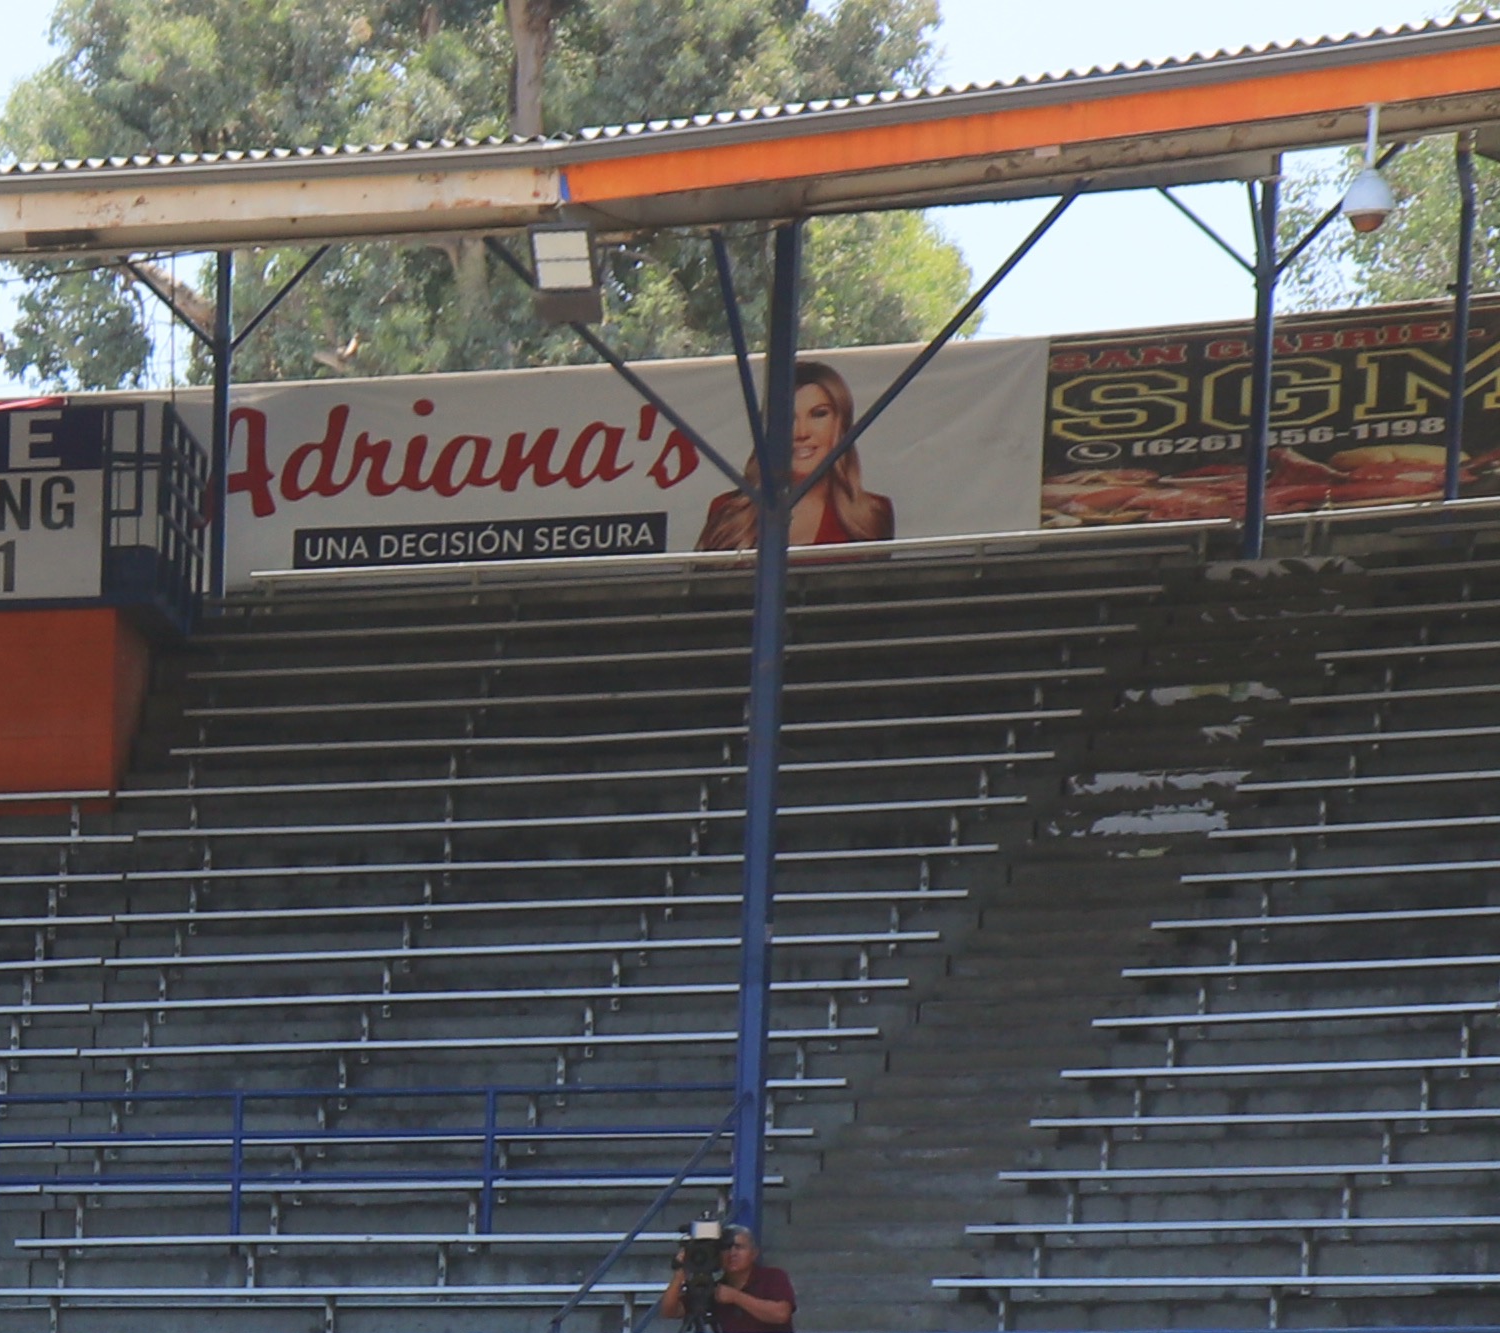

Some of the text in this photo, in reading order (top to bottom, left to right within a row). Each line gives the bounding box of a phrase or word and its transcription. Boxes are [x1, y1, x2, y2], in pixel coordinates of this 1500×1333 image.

[1050, 344, 1187, 372] SAN
[1131, 433, 1242, 458] (626)
[192, 398, 702, 529] Adriana's
[304, 522, 656, 562] UNA DECISIÓN SEGURA
